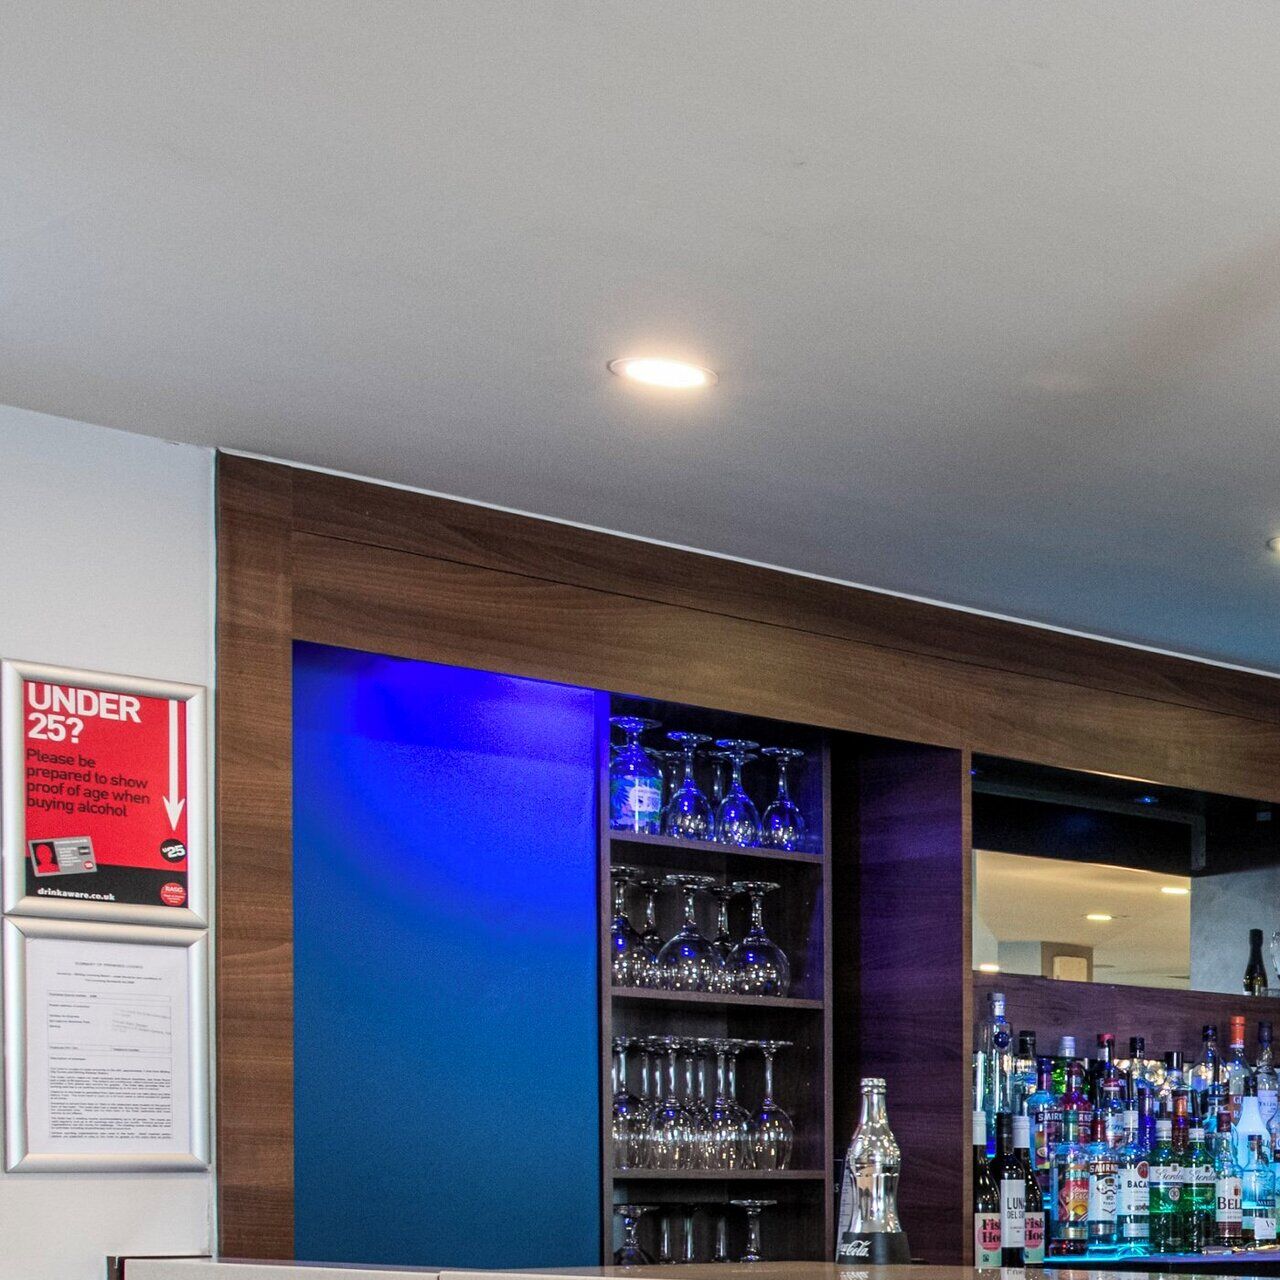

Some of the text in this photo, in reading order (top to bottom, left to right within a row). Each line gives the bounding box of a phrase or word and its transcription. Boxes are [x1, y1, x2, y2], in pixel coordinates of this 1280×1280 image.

[28, 682, 141, 724] UNDER
[28, 713, 84, 744] 25?
[27, 749, 96, 768] Please be
[26, 766, 149, 789] prepared to show
[26, 782, 150, 804] proof of age when
[26, 796, 127, 817] buying alcohol
[37, 887, 115, 901] drinkaware.co.uk
